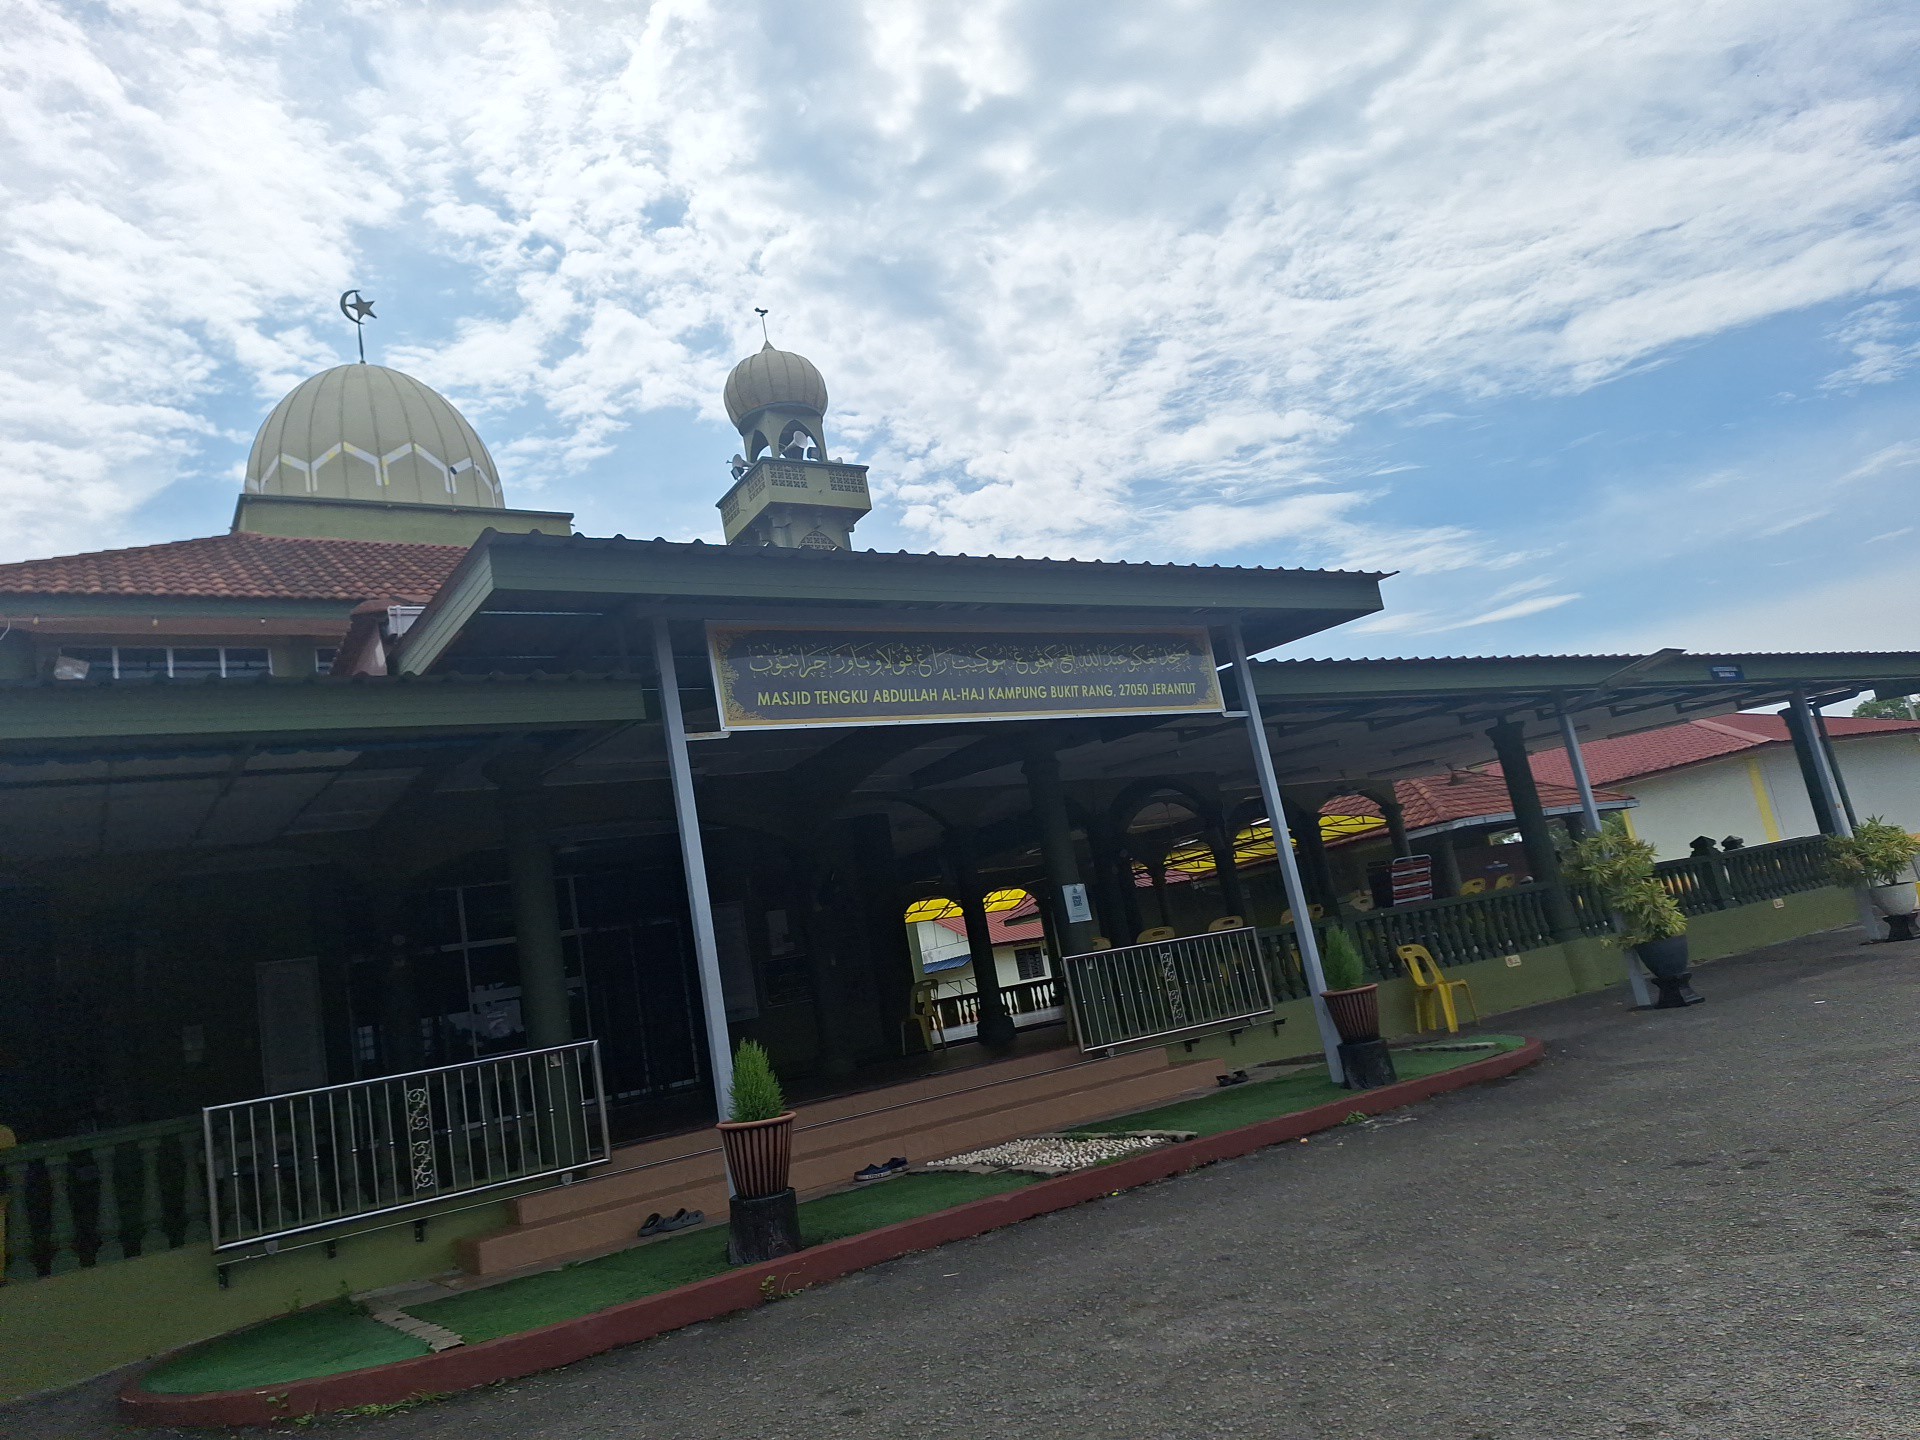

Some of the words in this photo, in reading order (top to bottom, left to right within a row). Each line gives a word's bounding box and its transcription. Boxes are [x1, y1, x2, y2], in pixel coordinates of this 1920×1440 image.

[758, 691, 811, 706] MASJID
[814, 690, 868, 705] TENGKU
[873, 688, 938, 703] ABDULLAH
[942, 687, 985, 701] AL-HAJ
[988, 686, 1047, 700] KAMPUNG
[1050, 685, 1079, 698] BUKIT
[1081, 684, 1116, 698] RANG,
[1118, 683, 1149, 696] 27050
[1151, 682, 1196, 695] JERANTUT
